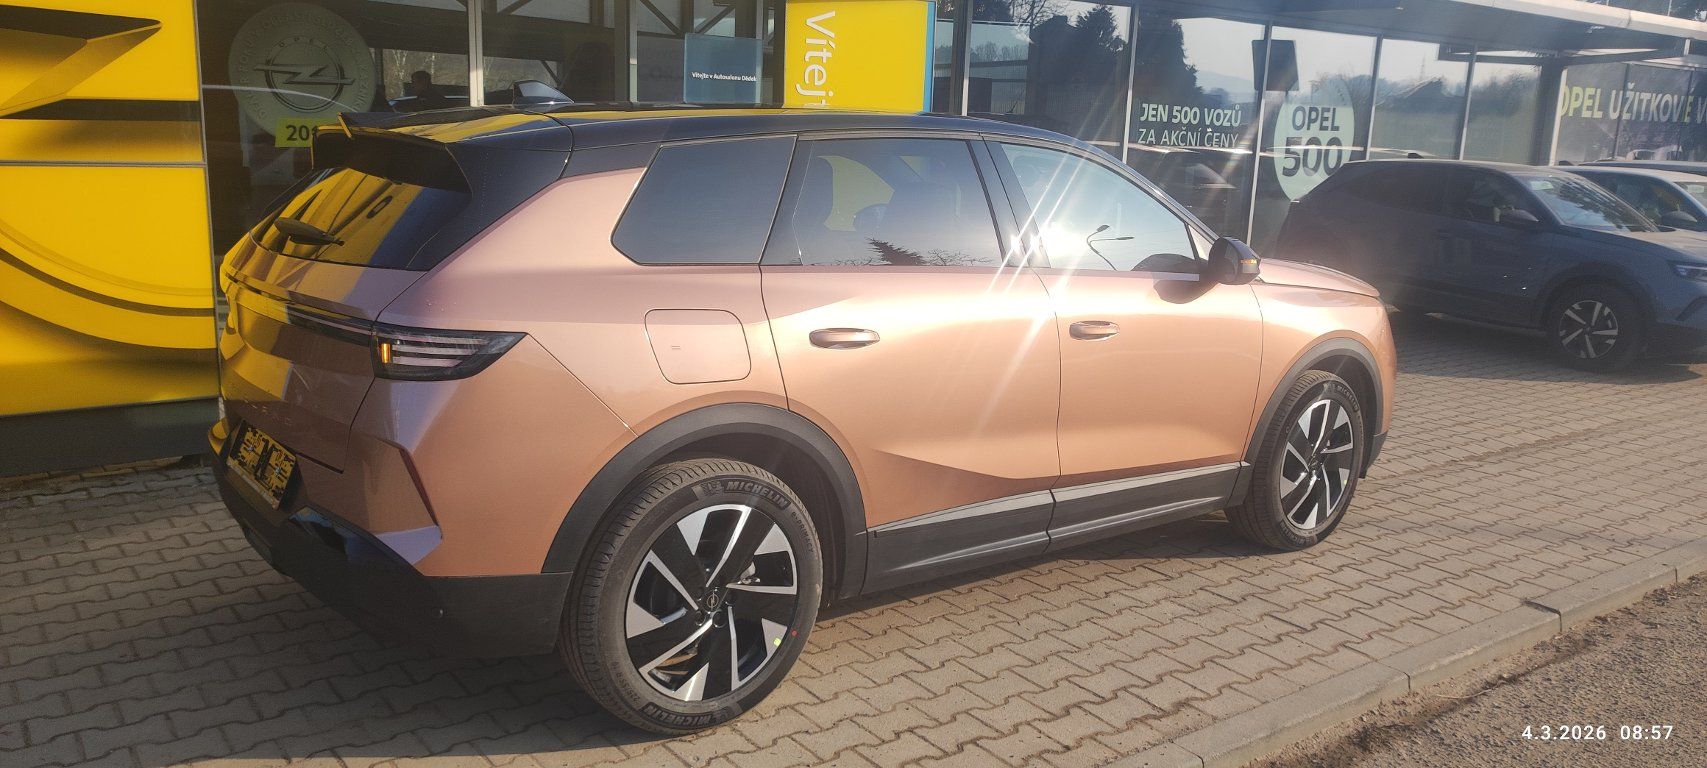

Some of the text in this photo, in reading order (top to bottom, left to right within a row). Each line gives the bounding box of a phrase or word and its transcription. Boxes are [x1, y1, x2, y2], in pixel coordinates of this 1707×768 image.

[1140, 103, 1242, 127] JEN 500 VOZŮ
[1609, 82, 1695, 123] UŽITKOVÉ
[1291, 105, 1340, 132] OPEL
[1137, 128, 1156, 145] ZA
[1160, 126, 1202, 147] AKČNÍ
[1282, 136, 1343, 177] 500
[726, 481, 788, 509] MICHELIN
[643, 703, 713, 727] MICHELIN
